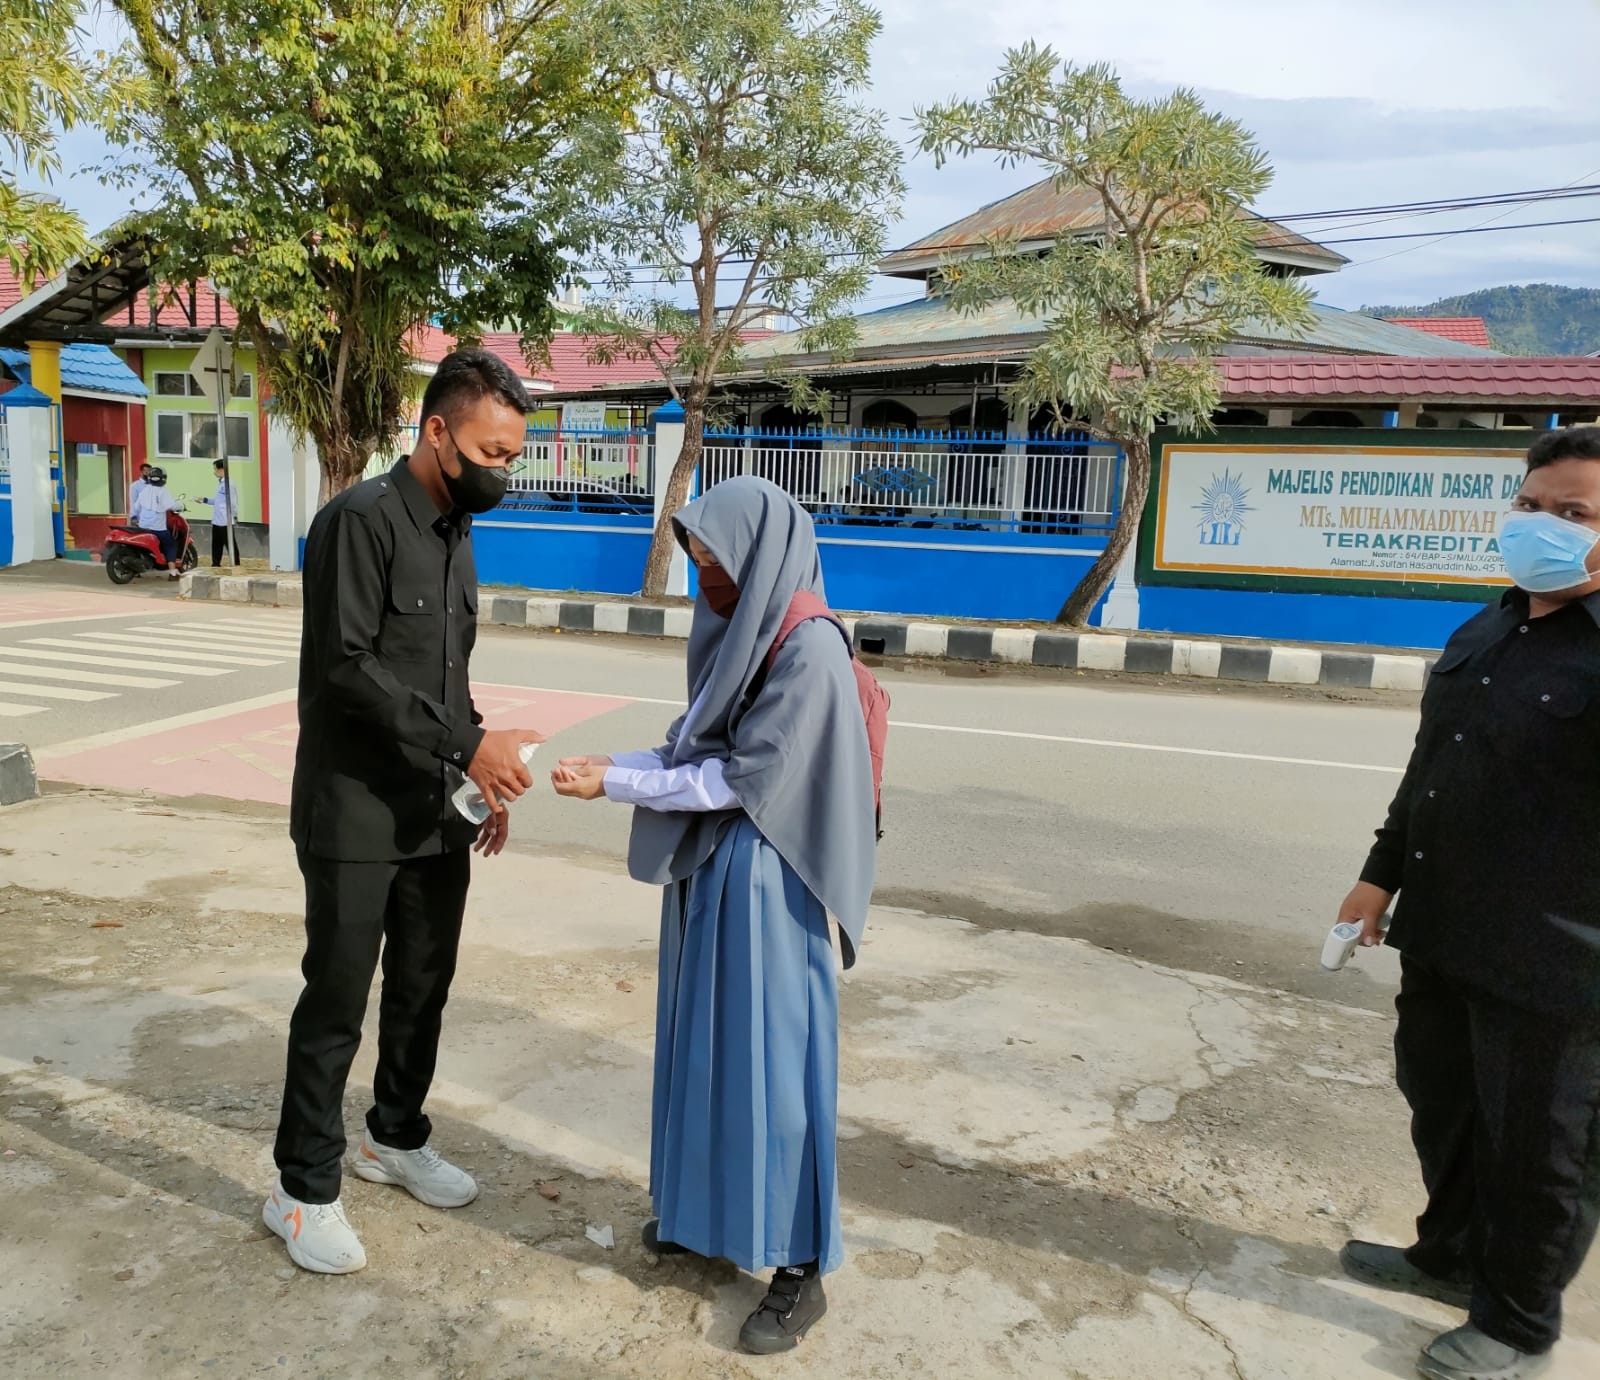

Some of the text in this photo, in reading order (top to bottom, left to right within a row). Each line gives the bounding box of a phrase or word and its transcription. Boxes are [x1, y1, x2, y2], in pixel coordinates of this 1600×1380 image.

[1267, 468, 1521, 499] MAJELIS PENDIDIKAN DASAR DA
[1300, 505, 1497, 533] MTs. MUHAMMADIYAH
[1322, 532, 1500, 553] TERAKREDITA
[1409, 561, 1464, 571] Hasanuddin
